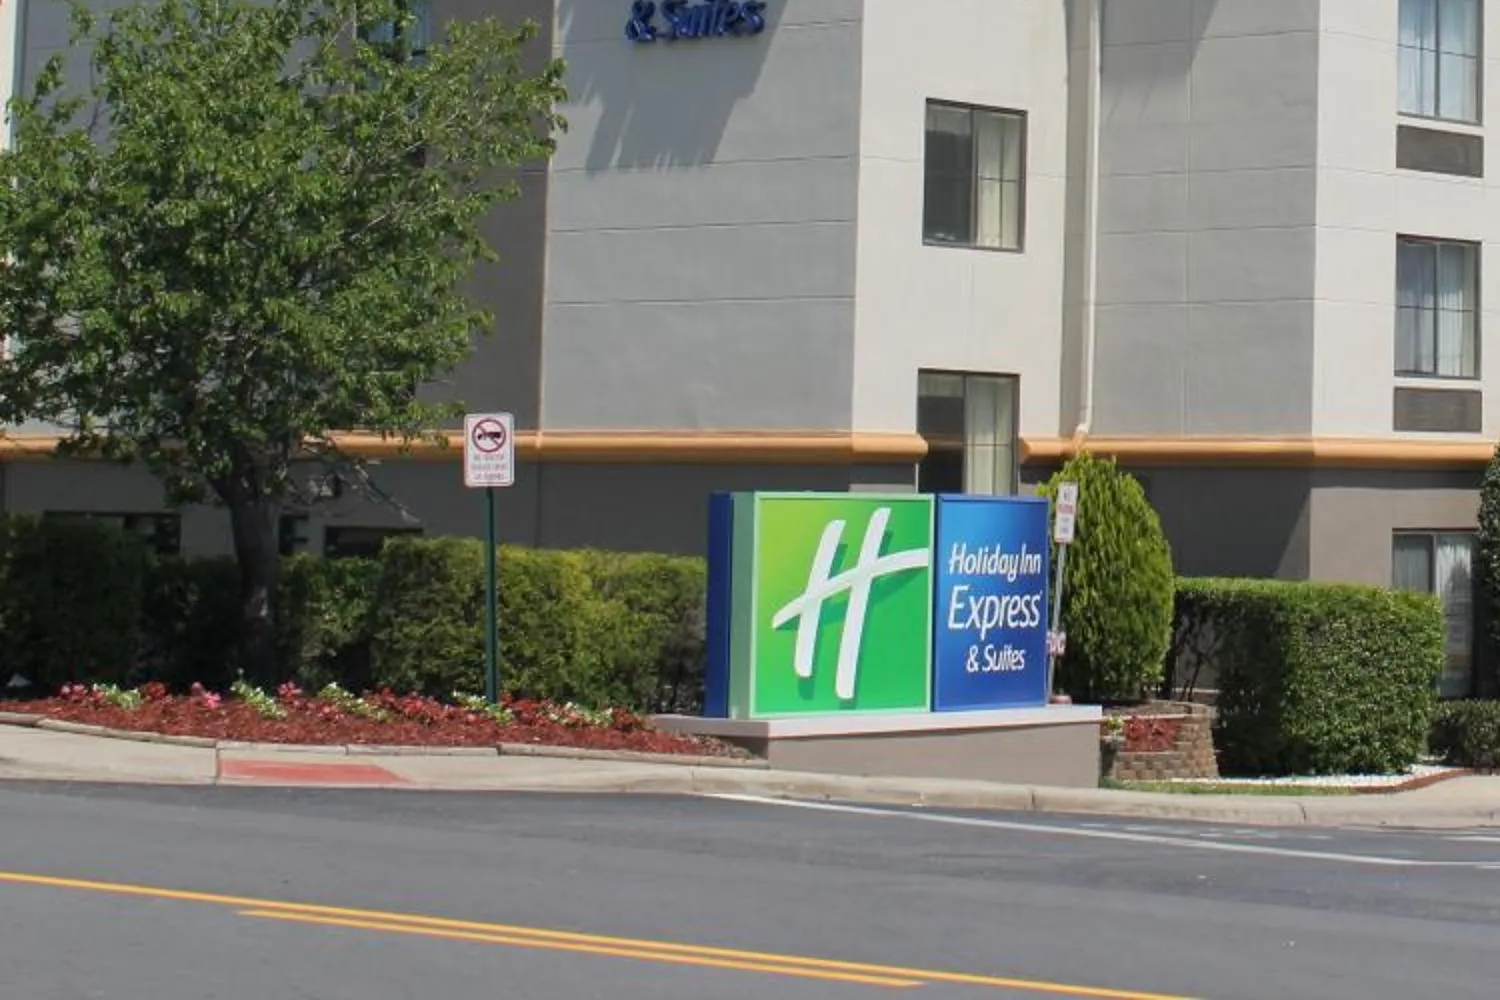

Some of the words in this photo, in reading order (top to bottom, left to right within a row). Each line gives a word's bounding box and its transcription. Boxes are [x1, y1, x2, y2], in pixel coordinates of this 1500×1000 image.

[948, 543, 1019, 583] Holiday
[1020, 543, 1042, 575] Inn
[948, 585, 1041, 642] Express
[965, 649, 980, 673] &
[982, 643, 1026, 673] Suites
